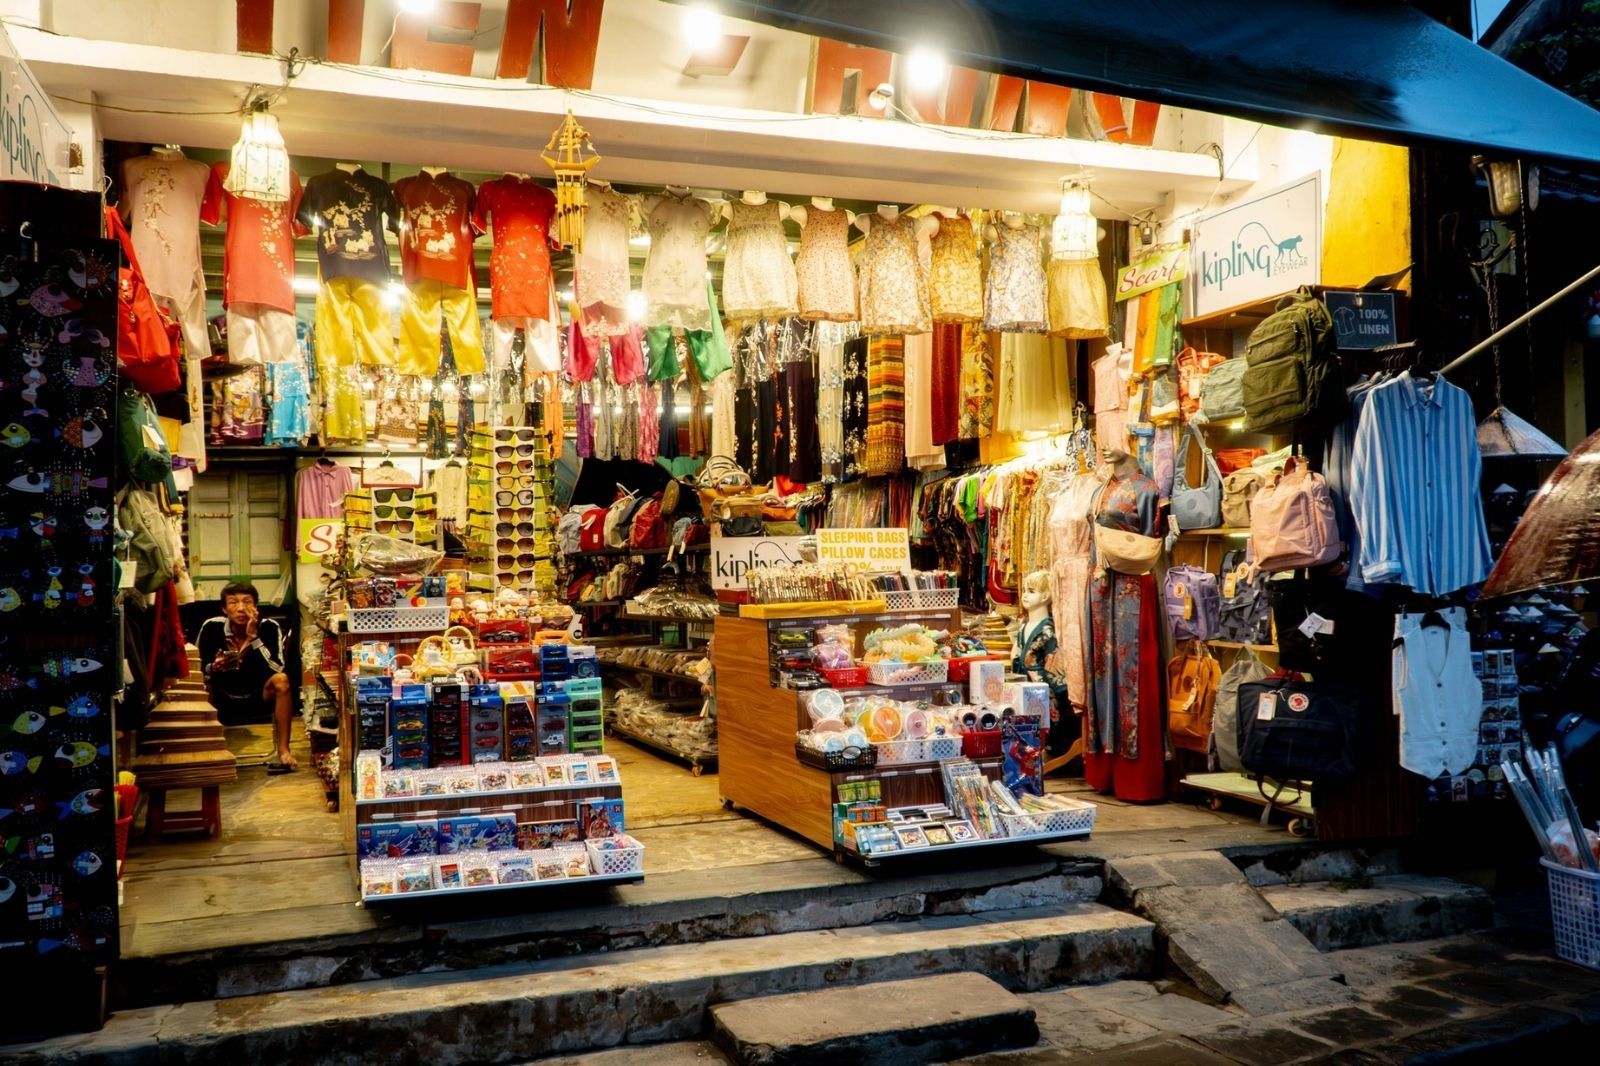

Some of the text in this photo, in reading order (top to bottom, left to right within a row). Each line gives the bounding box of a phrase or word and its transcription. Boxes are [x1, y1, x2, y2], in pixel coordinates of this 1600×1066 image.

[1119, 249, 1181, 293] Scarf
[1273, 257, 1309, 276] EYEWEAR
[1360, 309, 1388, 319] 100%
[1360, 324, 1390, 335] LINEN
[821, 532, 905, 543] SLEEPING BAGS
[821, 547, 906, 558] PILLOW CASES
